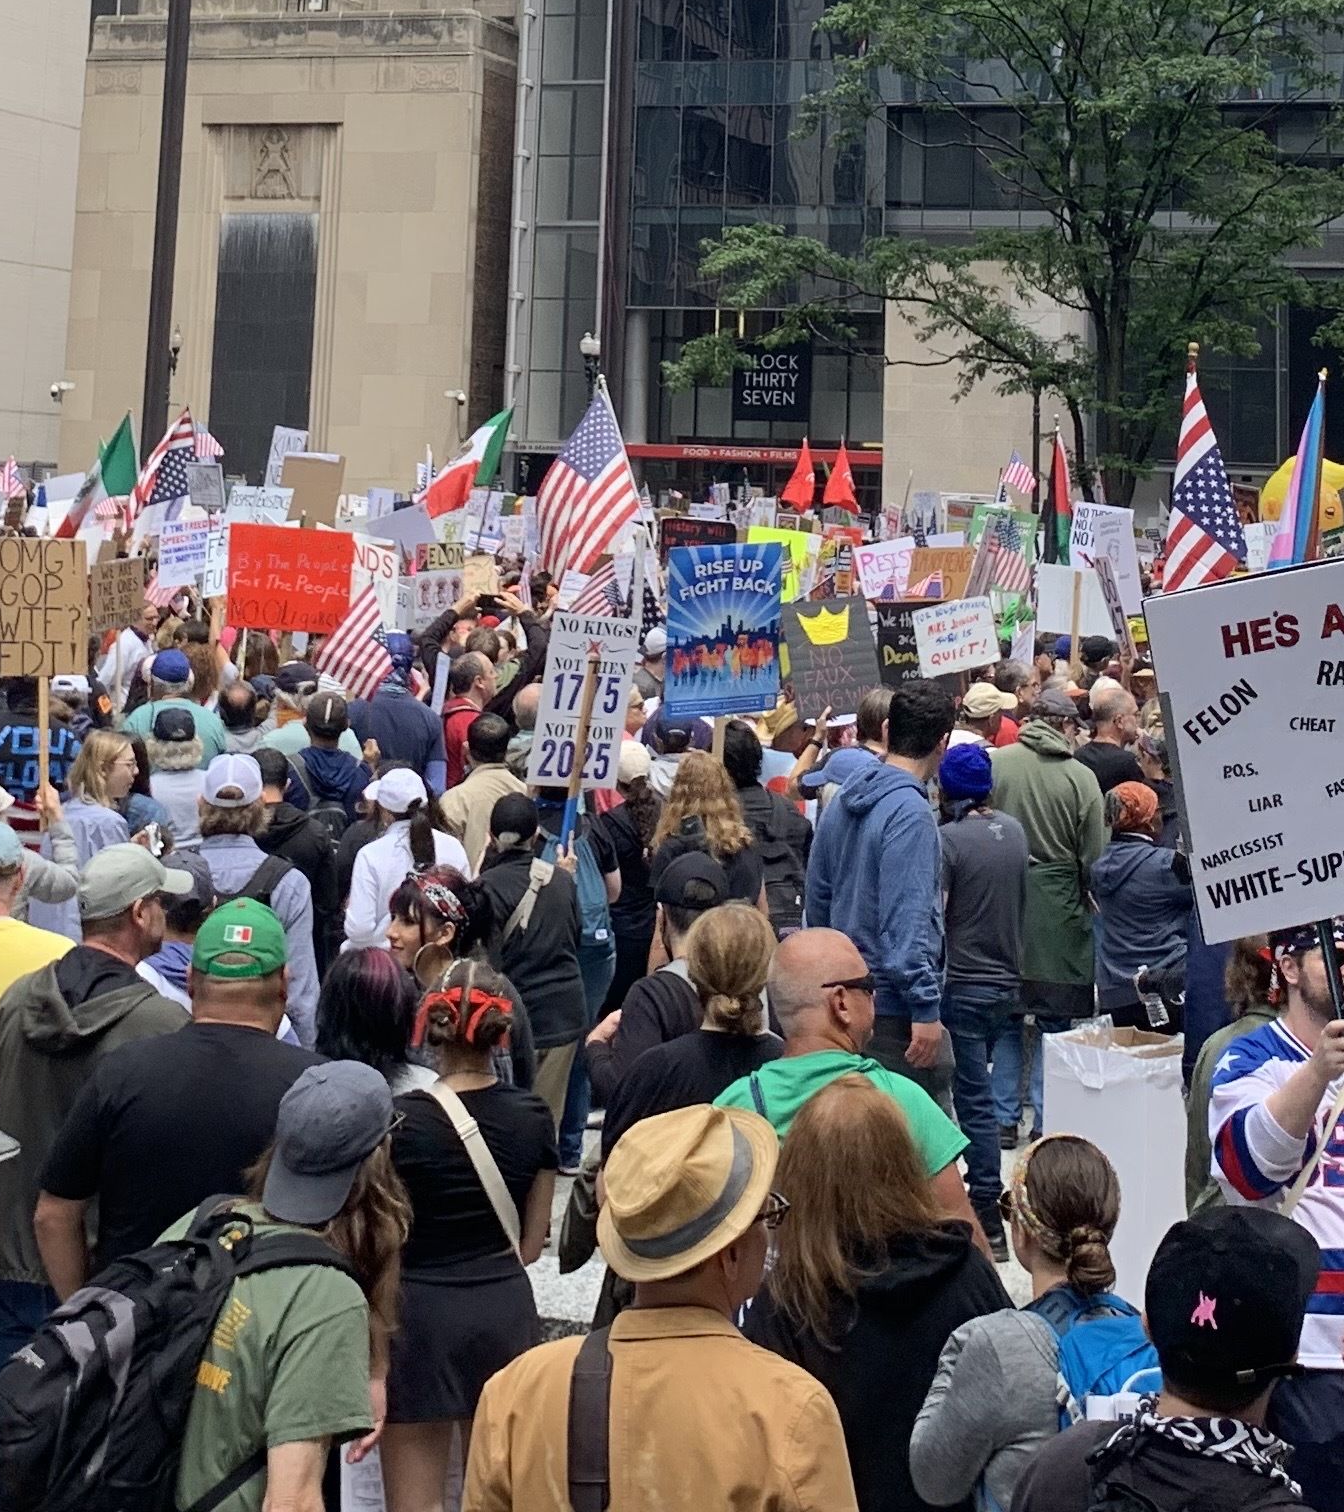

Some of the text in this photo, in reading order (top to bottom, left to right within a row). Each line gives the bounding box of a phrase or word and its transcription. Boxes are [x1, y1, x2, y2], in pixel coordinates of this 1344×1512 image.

[752, 354, 799, 370] LOCK
[743, 372, 799, 388] THIRTY
[743, 390, 795, 406] SEVEN
[683, 448, 798, 459] FOOD FASHION FILMS
[1076, 507, 1090, 519] NO
[1075, 520, 1089, 532] NO
[161, 536, 190, 546] SPEECH
[1073, 530, 1090, 547] NO
[0, 540, 76, 575] OMG!
[238, 552, 349, 576] By The People
[353, 544, 393, 579] NDS
[417, 545, 463, 568] FELON
[101, 566, 114, 579] WE
[695, 560, 763, 578] RISE UP
[0, 573, 63, 606] GOP
[231, 571, 349, 603] For The People
[679, 577, 776, 601] FIGHT BACK
[230, 597, 259, 624] NO
[880, 609, 897, 628] We
[0, 605, 81, 640] WTF?
[558, 618, 638, 639] NO KINGS!
[927, 620, 947, 636] MIKE
[962, 628, 972, 638] IS
[809, 647, 844, 668] NO
[931, 639, 987, 665] QUIET!
[553, 657, 584, 672] NOT
[803, 666, 855, 688] FAUX
[798, 686, 844, 712] KING
[1183, 678, 1258, 745] FELON
[543, 723, 576, 738] NOT
[1290, 716, 1336, 733] CHEAT
[1223, 762, 1259, 779] P.O.S.
[1248, 794, 1284, 812] LIAR
[1201, 833, 1285, 871] NARCISSIST
